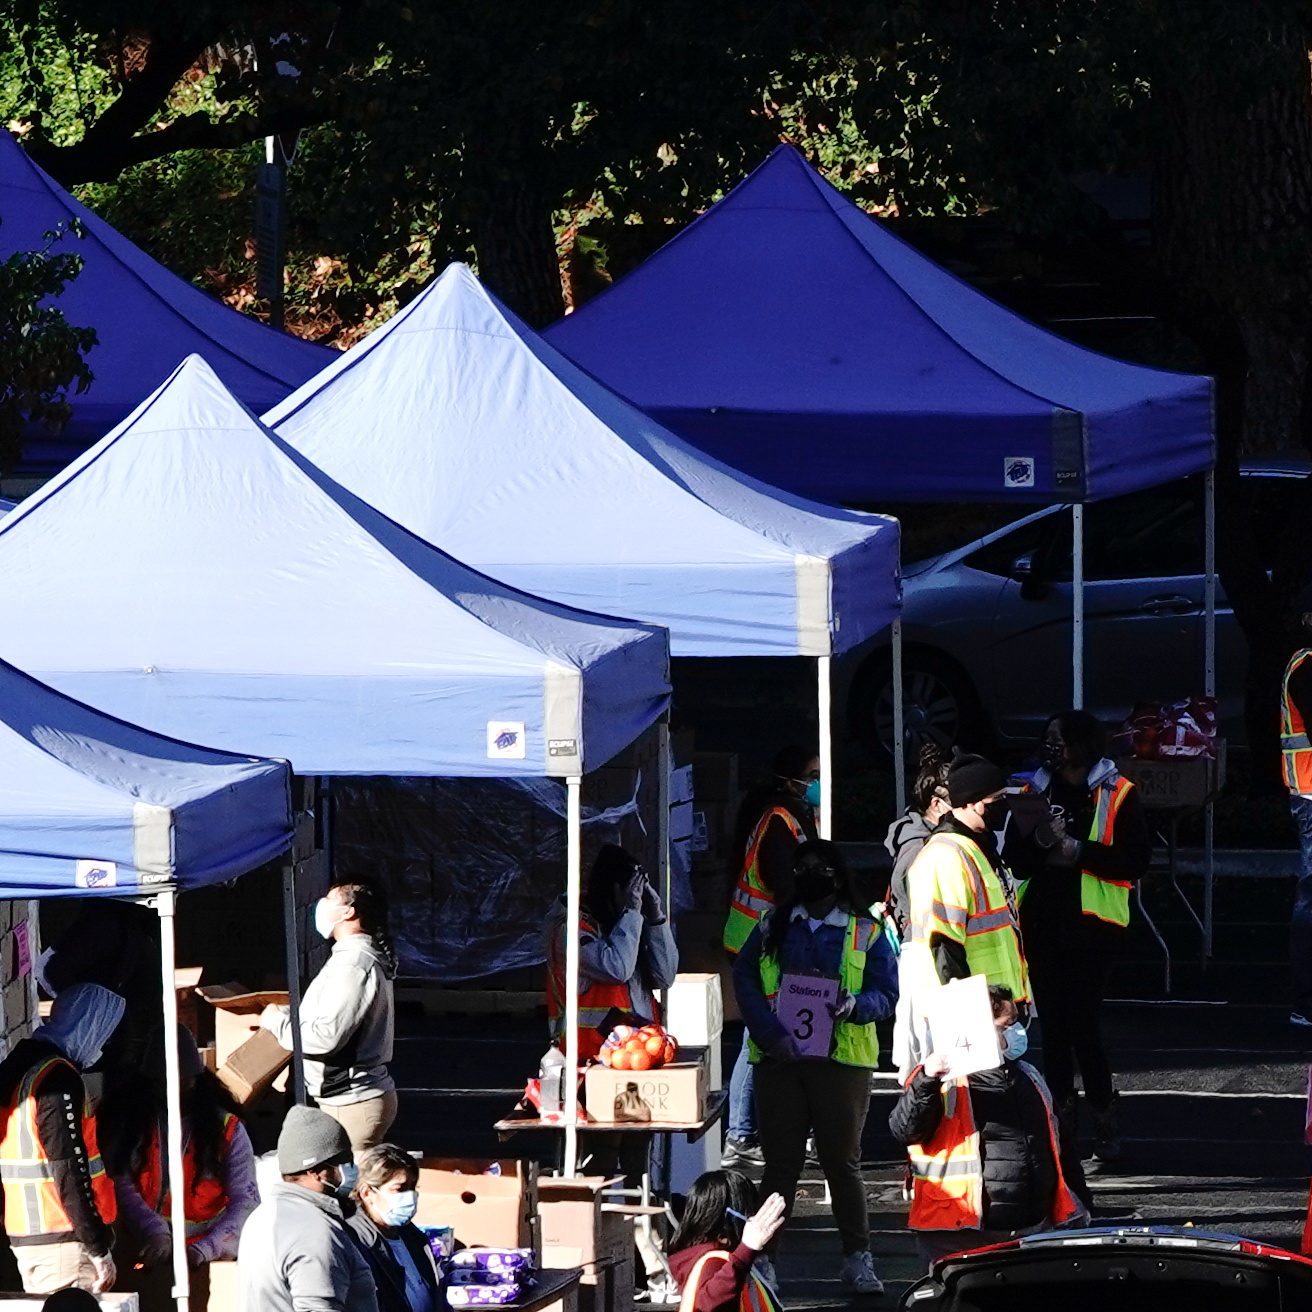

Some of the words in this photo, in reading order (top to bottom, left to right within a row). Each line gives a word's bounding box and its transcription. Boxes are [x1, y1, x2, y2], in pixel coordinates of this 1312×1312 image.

[789, 984, 822, 997] Station
[793, 1008, 814, 1040] 3
[615, 1081, 670, 1096] FOD
